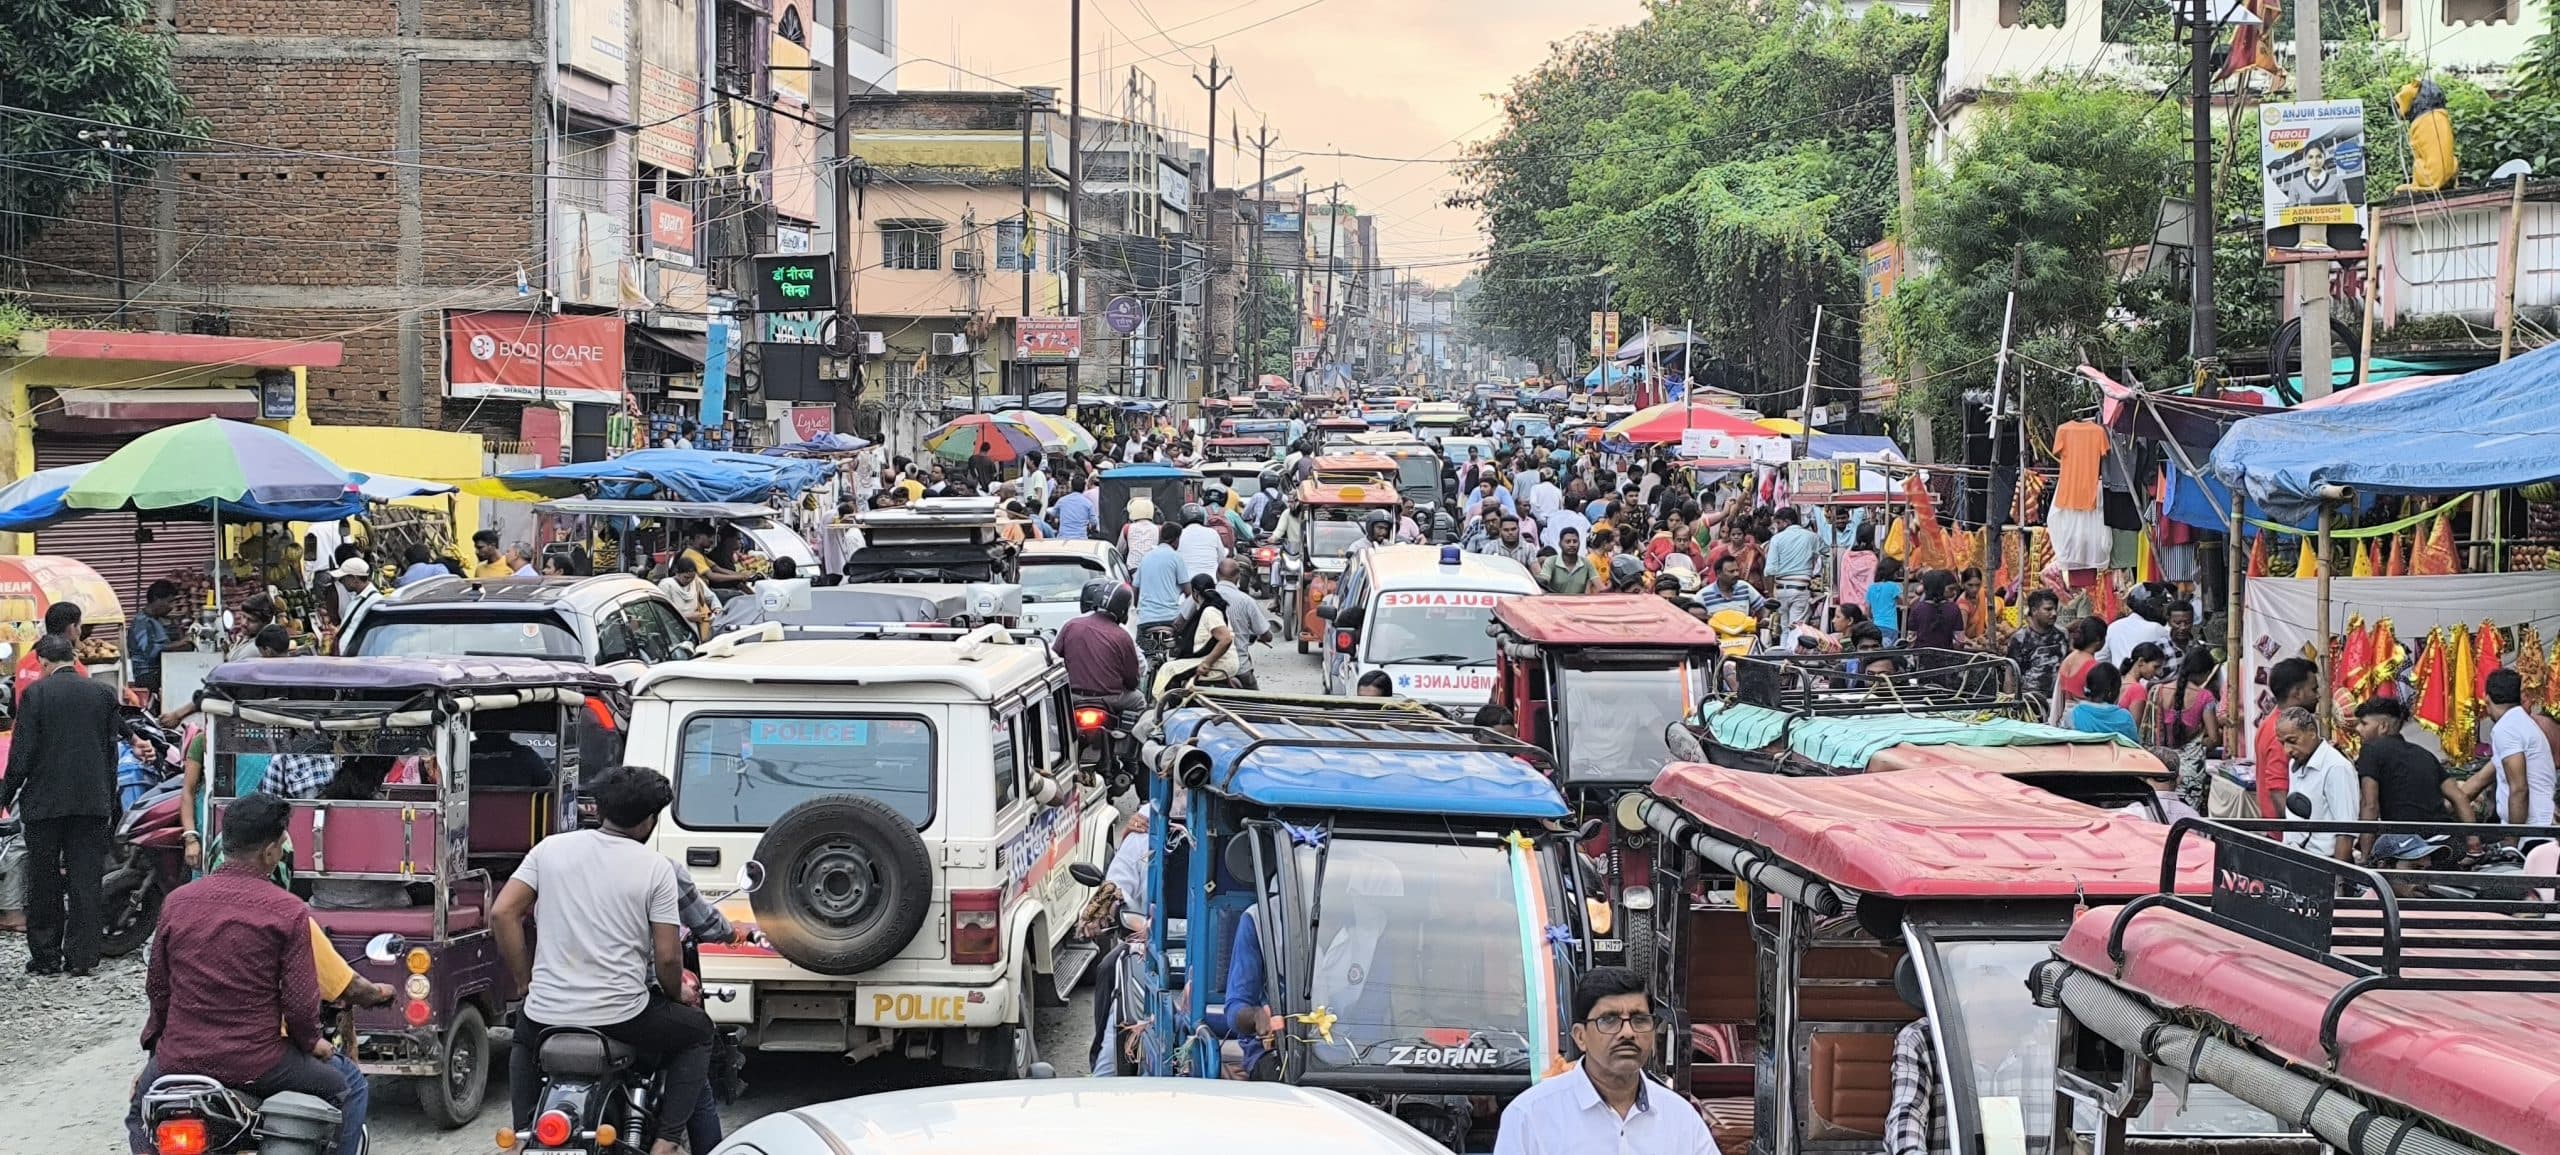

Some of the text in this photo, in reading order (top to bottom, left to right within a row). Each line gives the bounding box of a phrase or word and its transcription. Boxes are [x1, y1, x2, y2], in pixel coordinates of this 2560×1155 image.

[2282, 105, 2361, 118] ANJUM SANSKAR
[2271, 129, 2308, 140] ENROLL
[2278, 141, 2300, 149] NOW
[2292, 207, 2341, 216] ADMISSION
[771, 266, 815, 281] डॉ नीरज
[781, 282, 811, 298] सिन्हा
[499, 342, 604, 362] BODYCARE
[760, 723, 857, 742] POLICE
[2219, 867, 2265, 898] NEO
[872, 992, 966, 1022] POLICE
[1386, 1044, 1499, 1067] ZEOFINE
